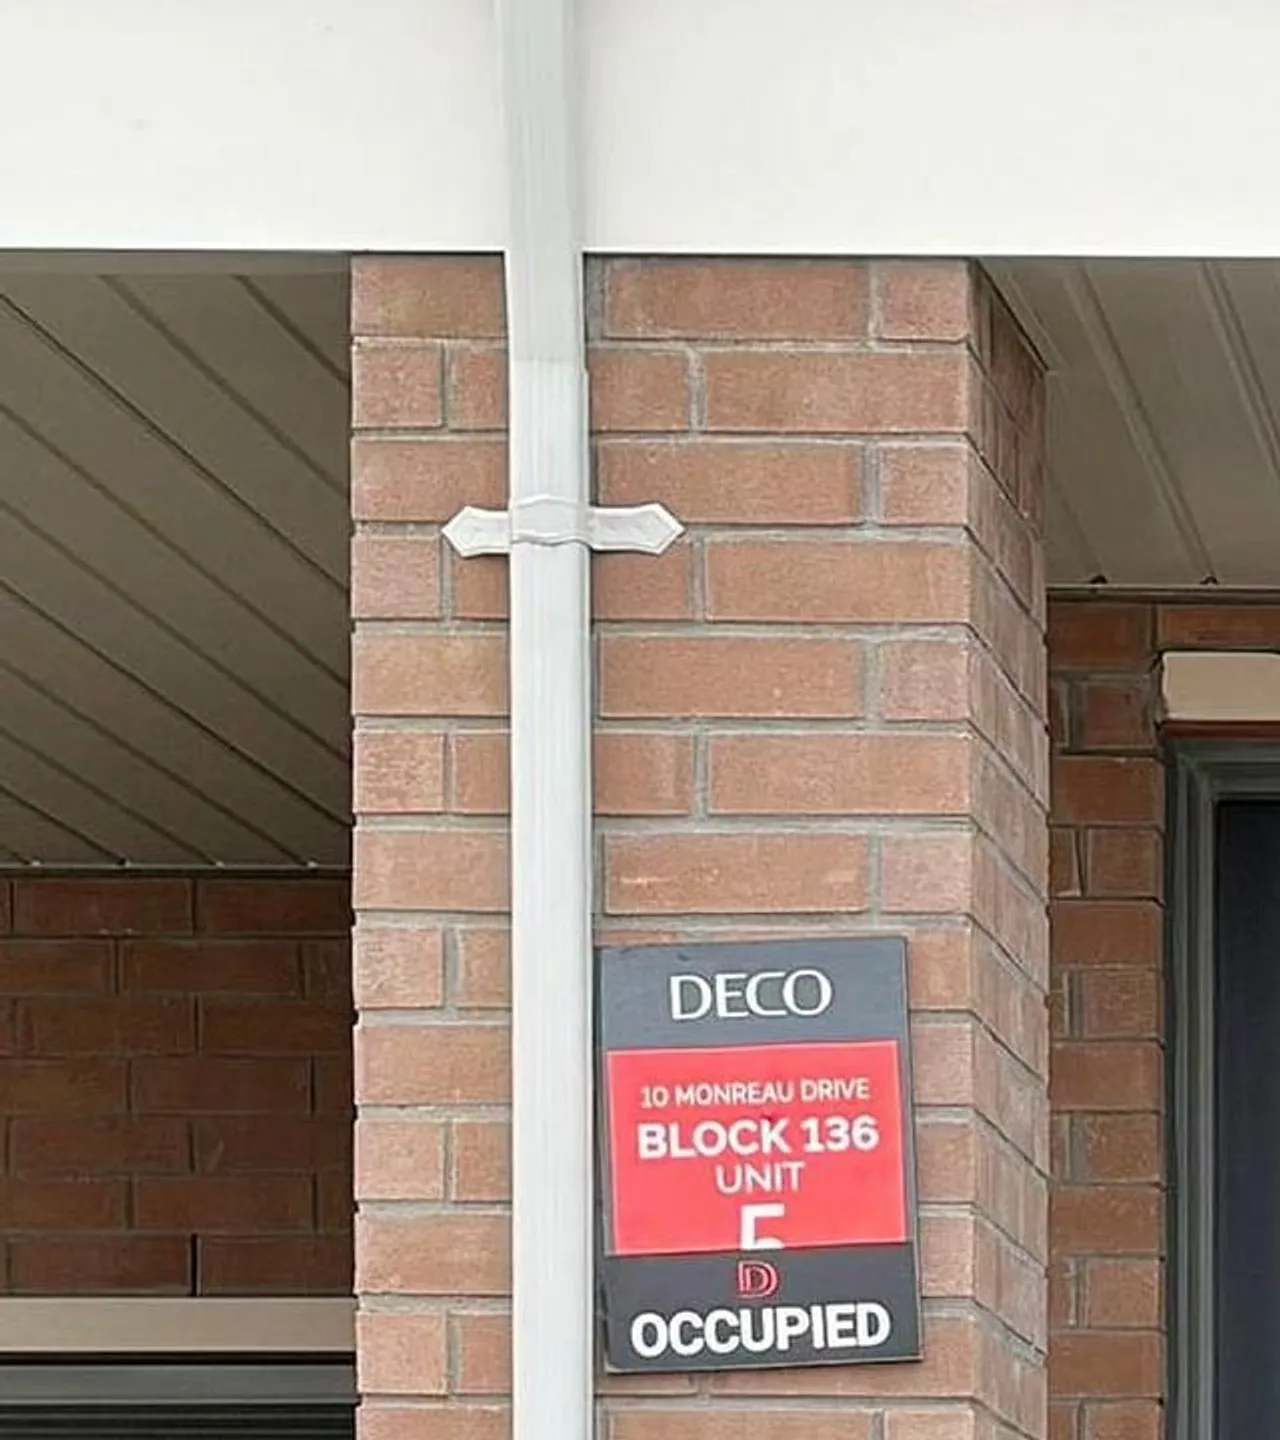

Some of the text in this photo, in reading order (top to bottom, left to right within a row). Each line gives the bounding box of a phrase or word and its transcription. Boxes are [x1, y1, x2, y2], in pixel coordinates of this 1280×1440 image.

[669, 969, 834, 1020] DECO
[640, 1085, 668, 1108] 10
[800, 1077, 871, 1103] DRIVE
[638, 1115, 879, 1159] BLOCK 136
[714, 1161, 805, 1195] UNIT
[630, 1302, 892, 1358] OCCUPIED
